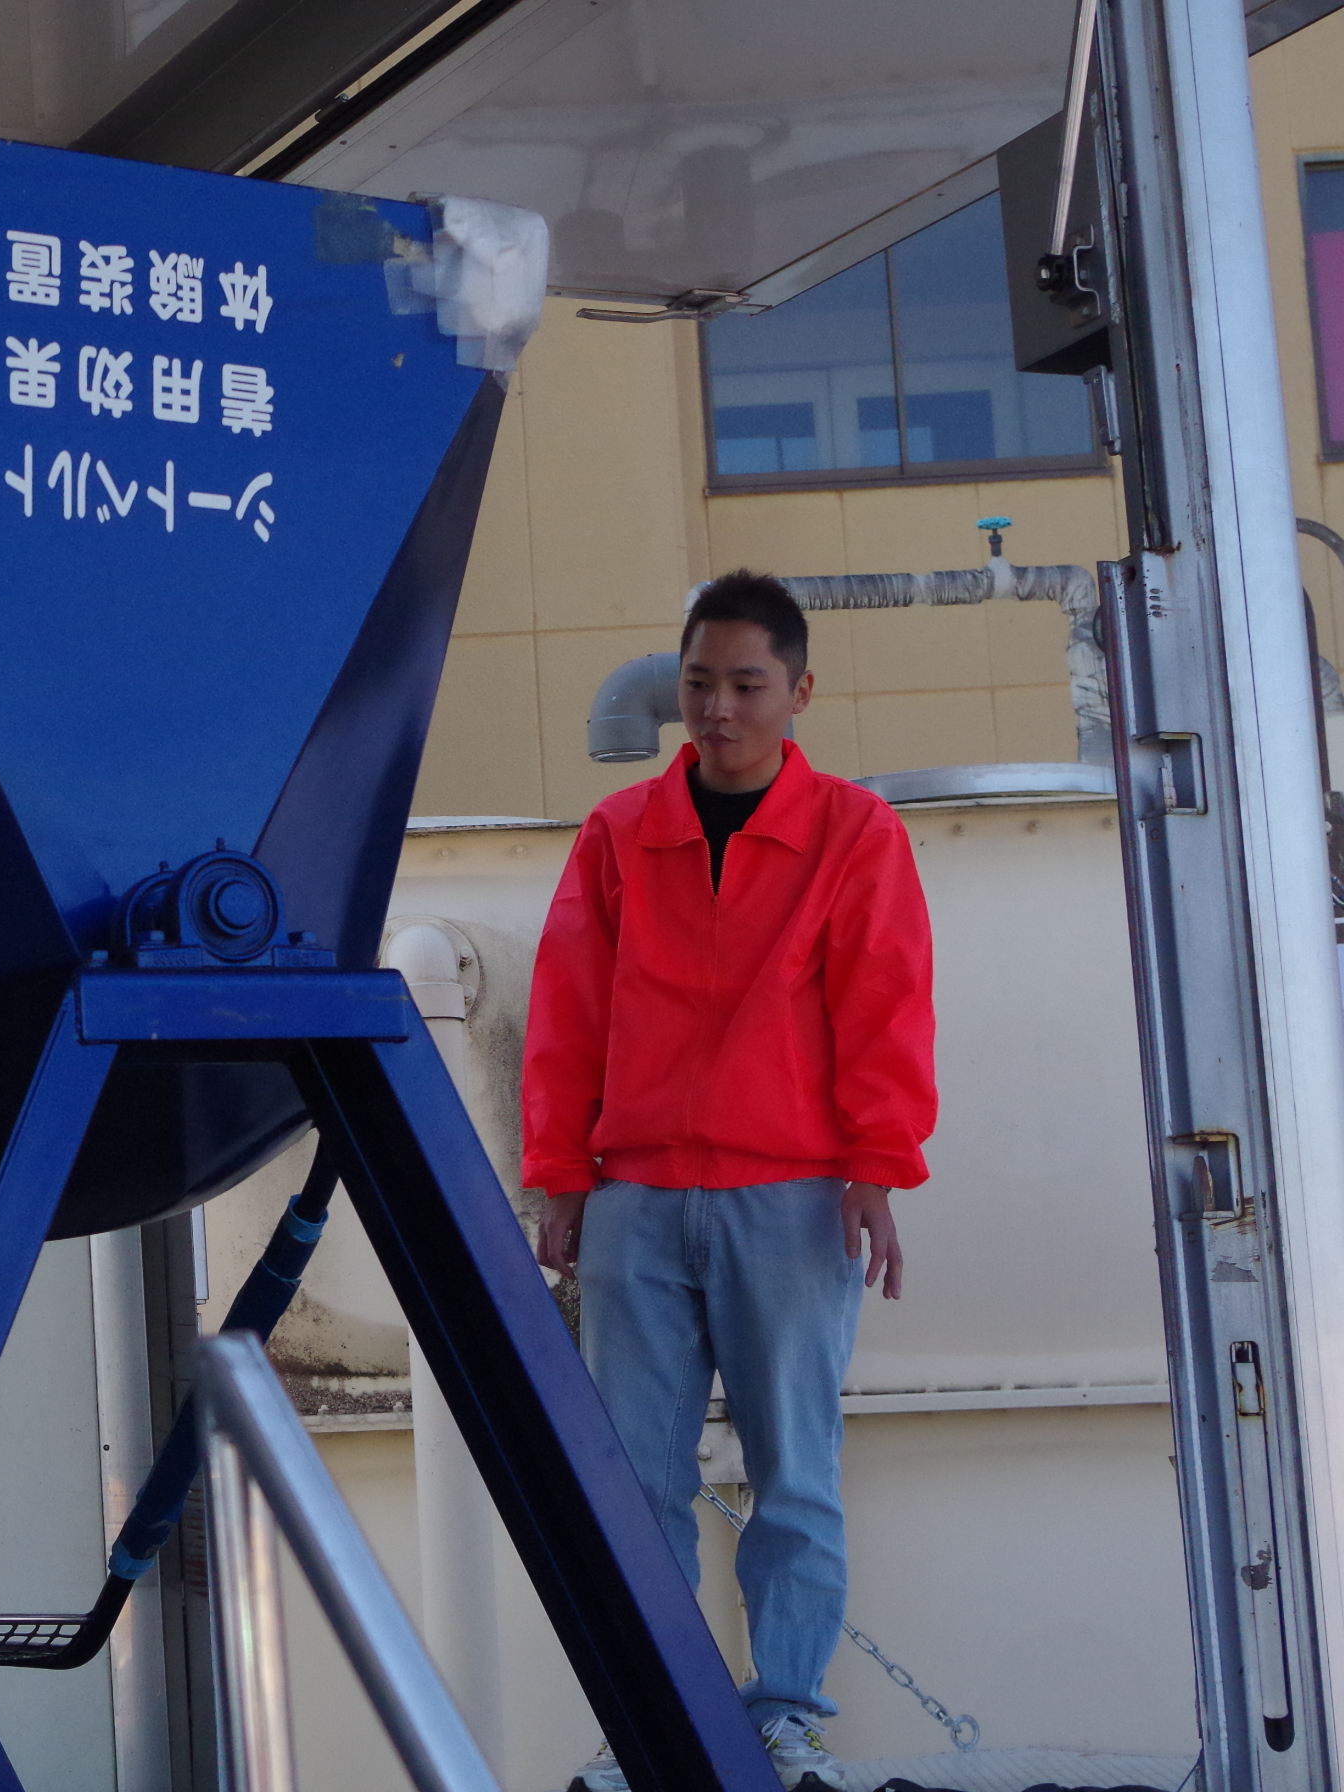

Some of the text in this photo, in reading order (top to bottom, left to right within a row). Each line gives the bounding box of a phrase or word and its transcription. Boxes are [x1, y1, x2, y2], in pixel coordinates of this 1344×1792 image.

[6, 229, 274, 334] 体験装置
[6, 335, 275, 438] 着用効果
[4, 443, 275, 543] シートベルト
